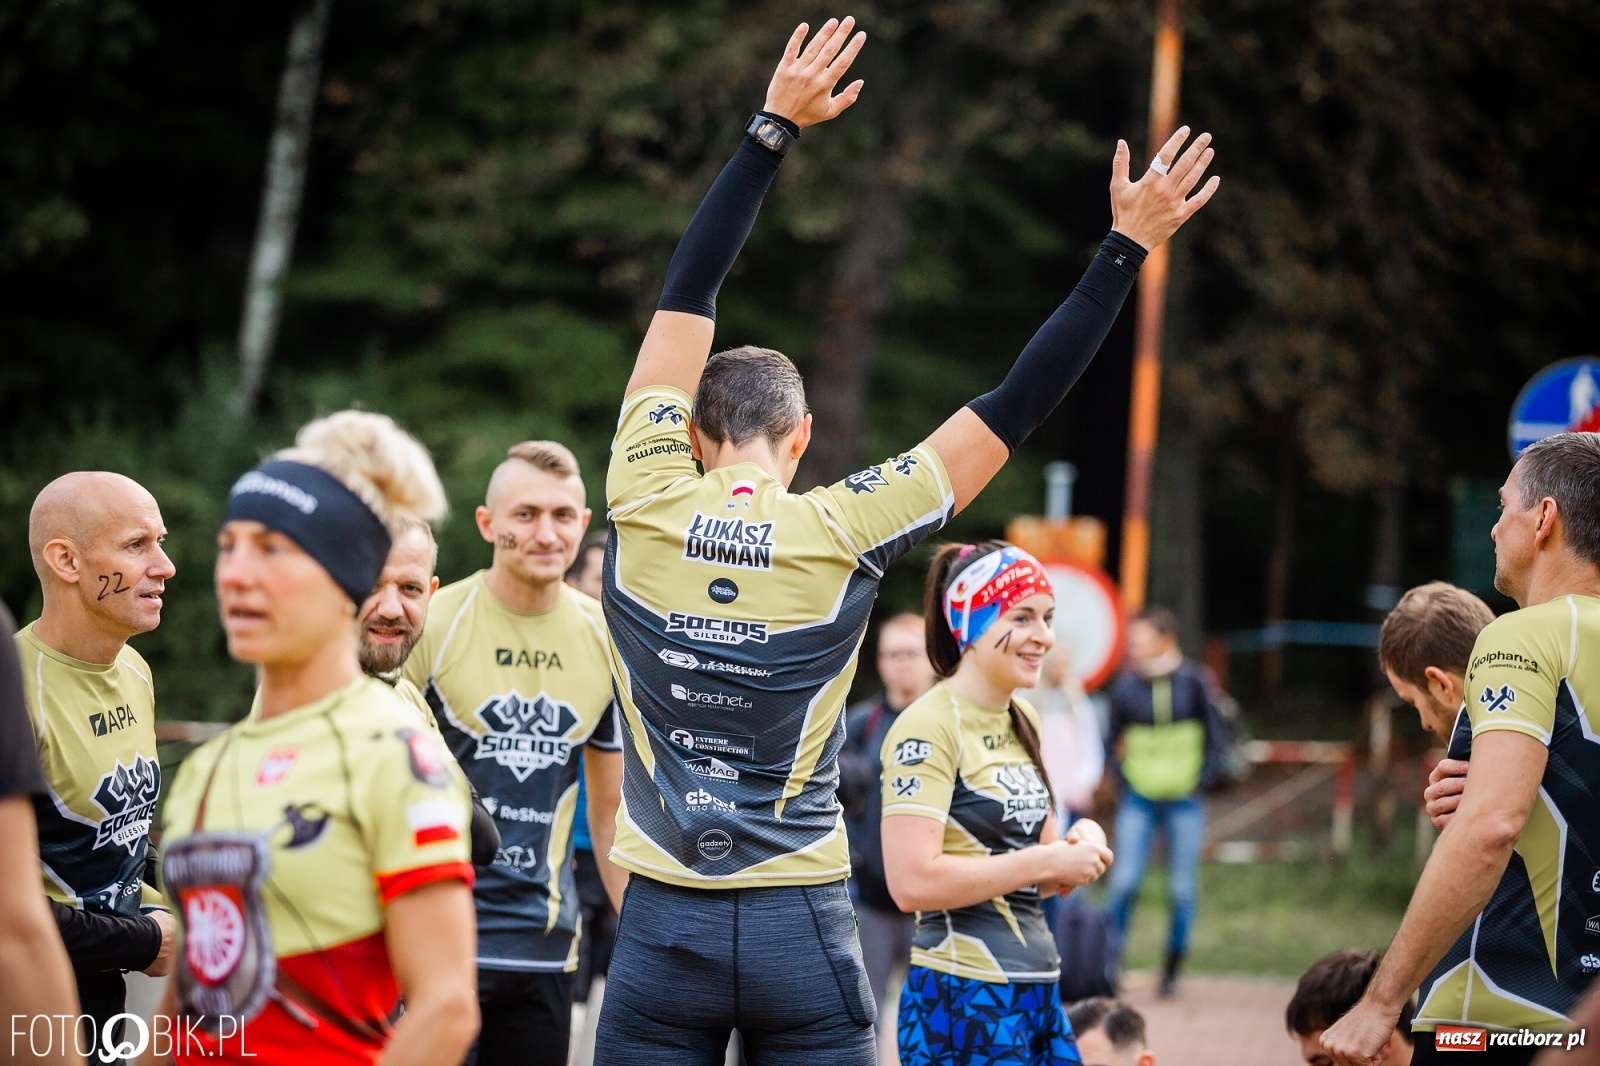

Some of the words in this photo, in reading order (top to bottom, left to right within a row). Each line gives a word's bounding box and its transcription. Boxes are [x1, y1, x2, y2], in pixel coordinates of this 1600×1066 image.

[688, 514, 773, 547] ŁUKASZ
[686, 535, 770, 568] DOMAN
[97, 571, 131, 602] 22
[669, 612, 767, 642] SOCIOS
[693, 631, 737, 642] SILESIA
[516, 650, 563, 670] APA
[687, 688, 753, 709] bradnet.pl
[107, 703, 138, 734] APA
[482, 736, 569, 760] SOCIOS
[694, 743, 749, 755] CONSTRUCTION
[695, 736, 729, 746] EXTREME
[98, 800, 156, 845] SOCIOS
[117, 824, 146, 841] SILESIA
[699, 839, 731, 849] gadzety
